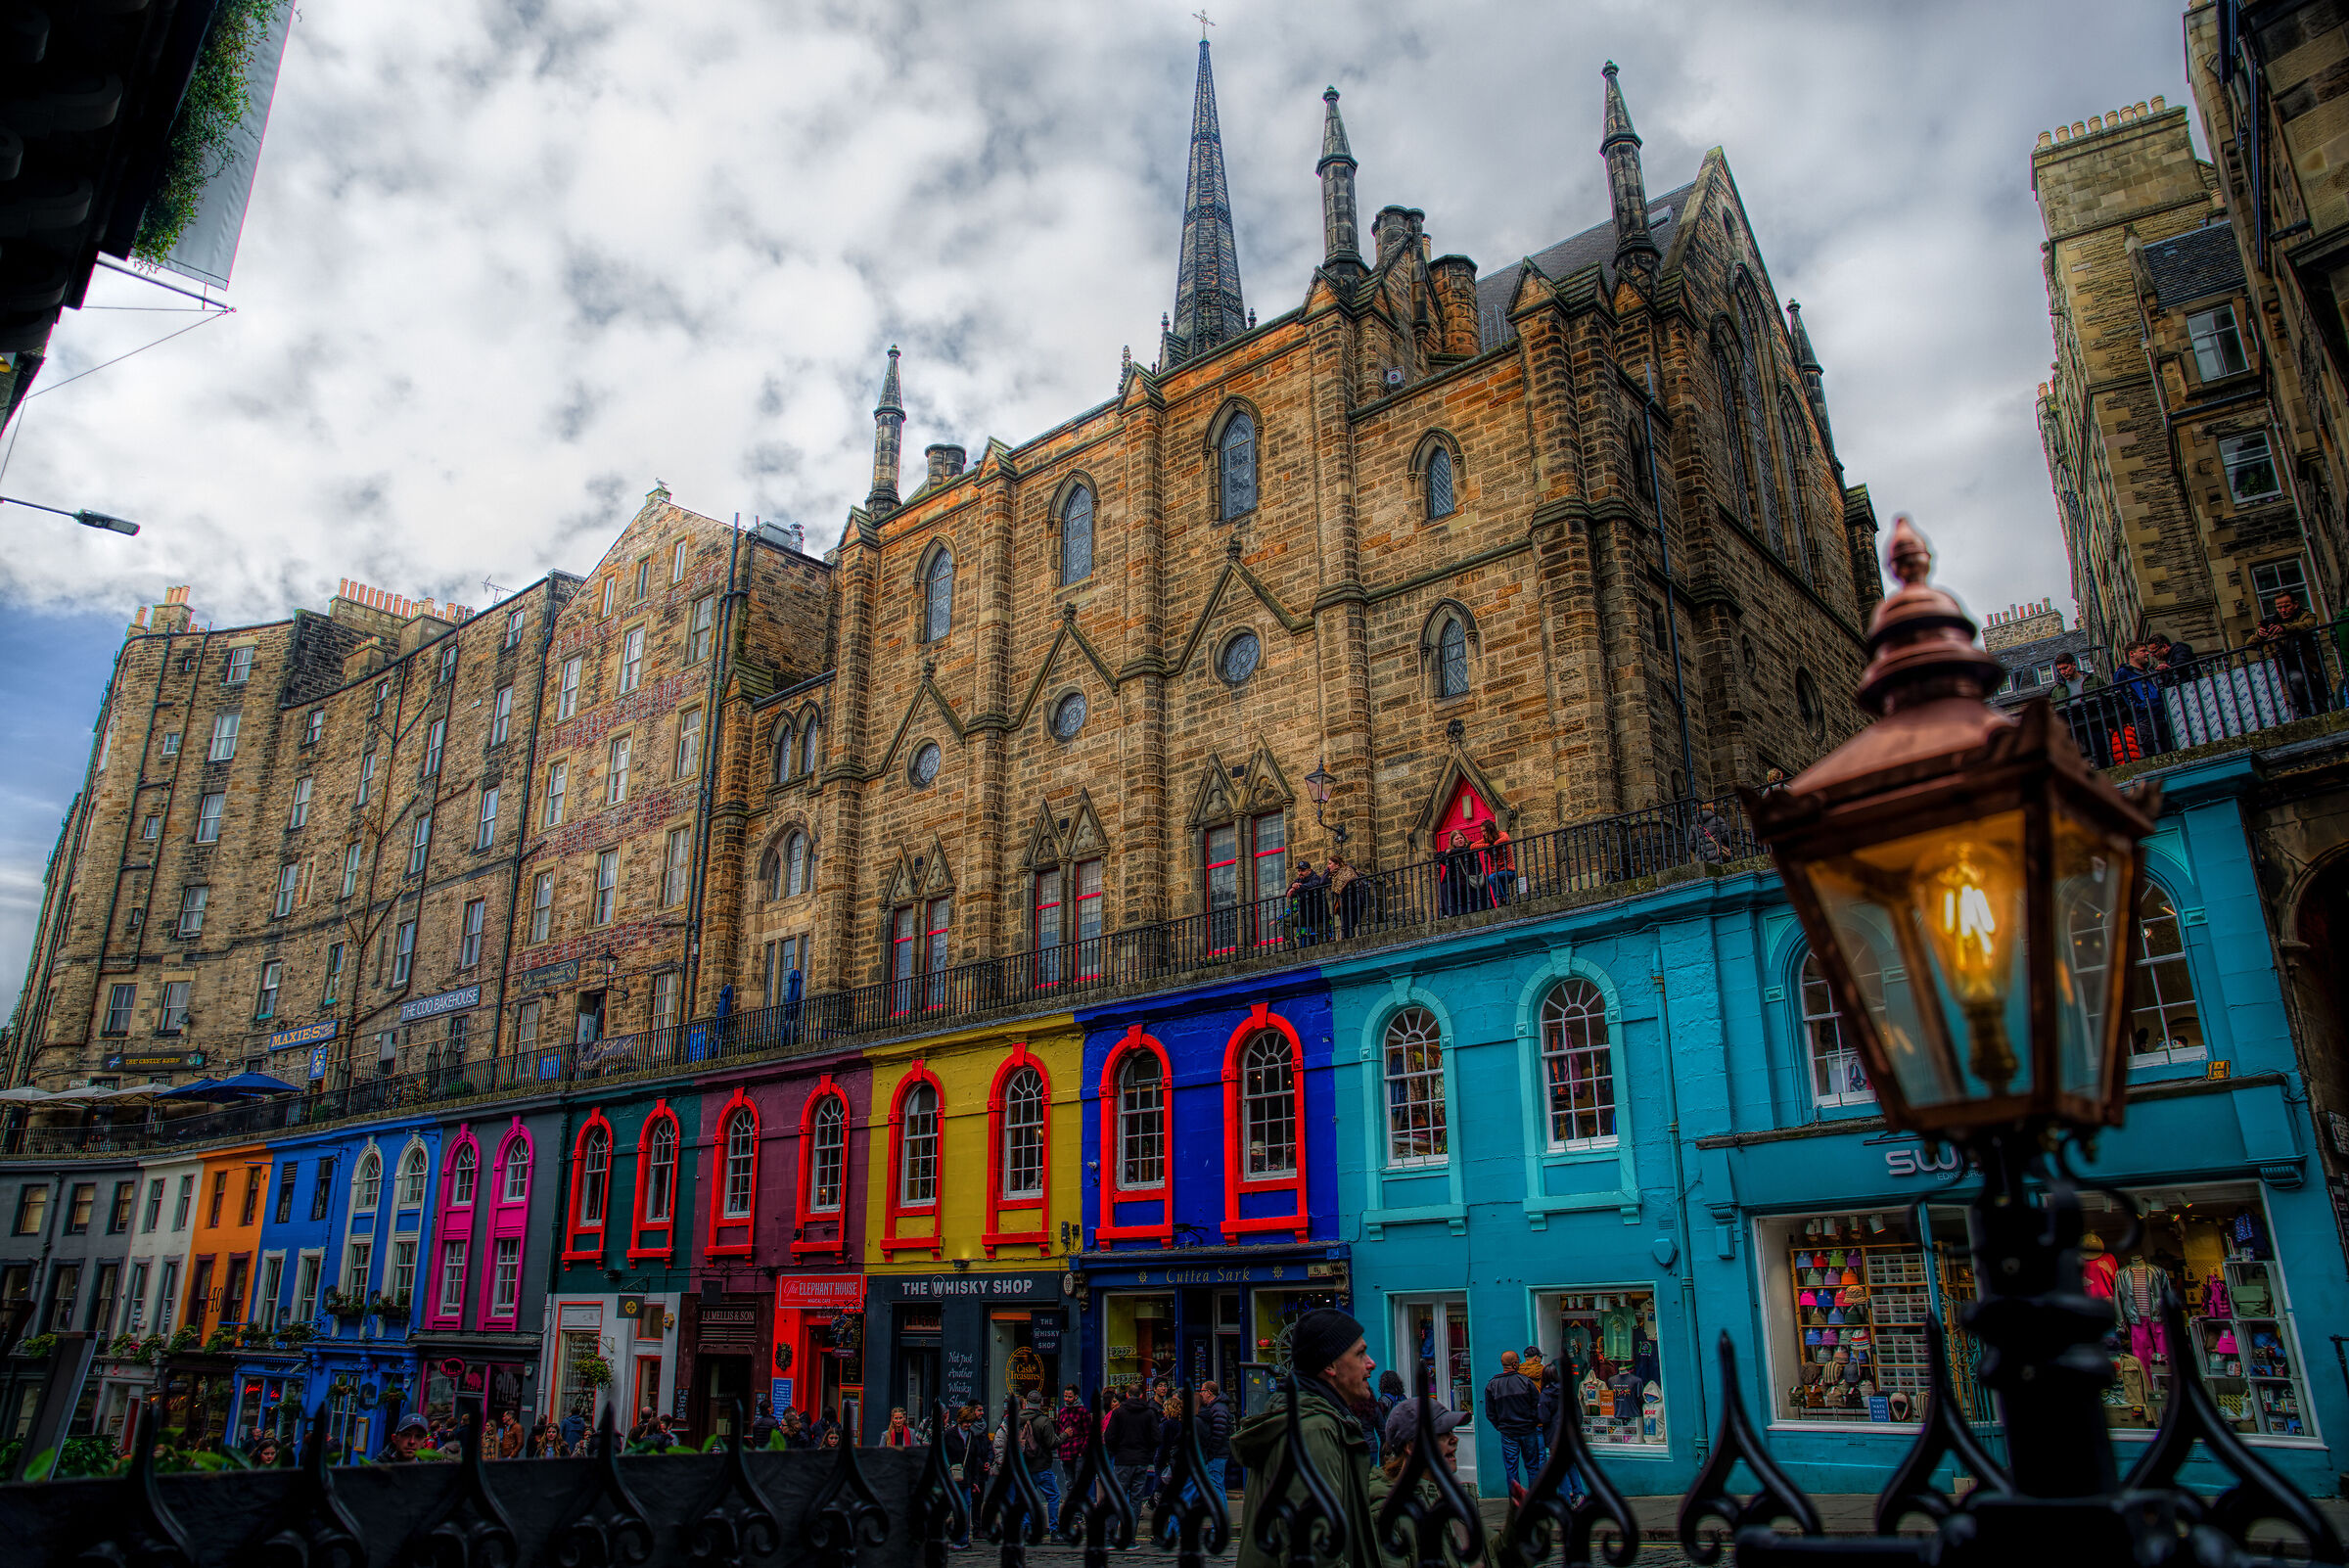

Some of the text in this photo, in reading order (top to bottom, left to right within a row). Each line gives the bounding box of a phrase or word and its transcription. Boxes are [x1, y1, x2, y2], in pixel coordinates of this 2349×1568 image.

[402, 989, 479, 1019] THE COO BAKEHOUSE
[270, 1026, 321, 1047] MAXIES
[1217, 1266, 1252, 1281] Sark
[783, 1279, 858, 1297] The ELEPHANT HOUSE
[901, 1278, 1035, 1296] THE WHISKY SHOP
[208, 1287, 224, 1313] 40
[948, 1367, 973, 1378] Another
[948, 1381, 972, 1399] Whisky
